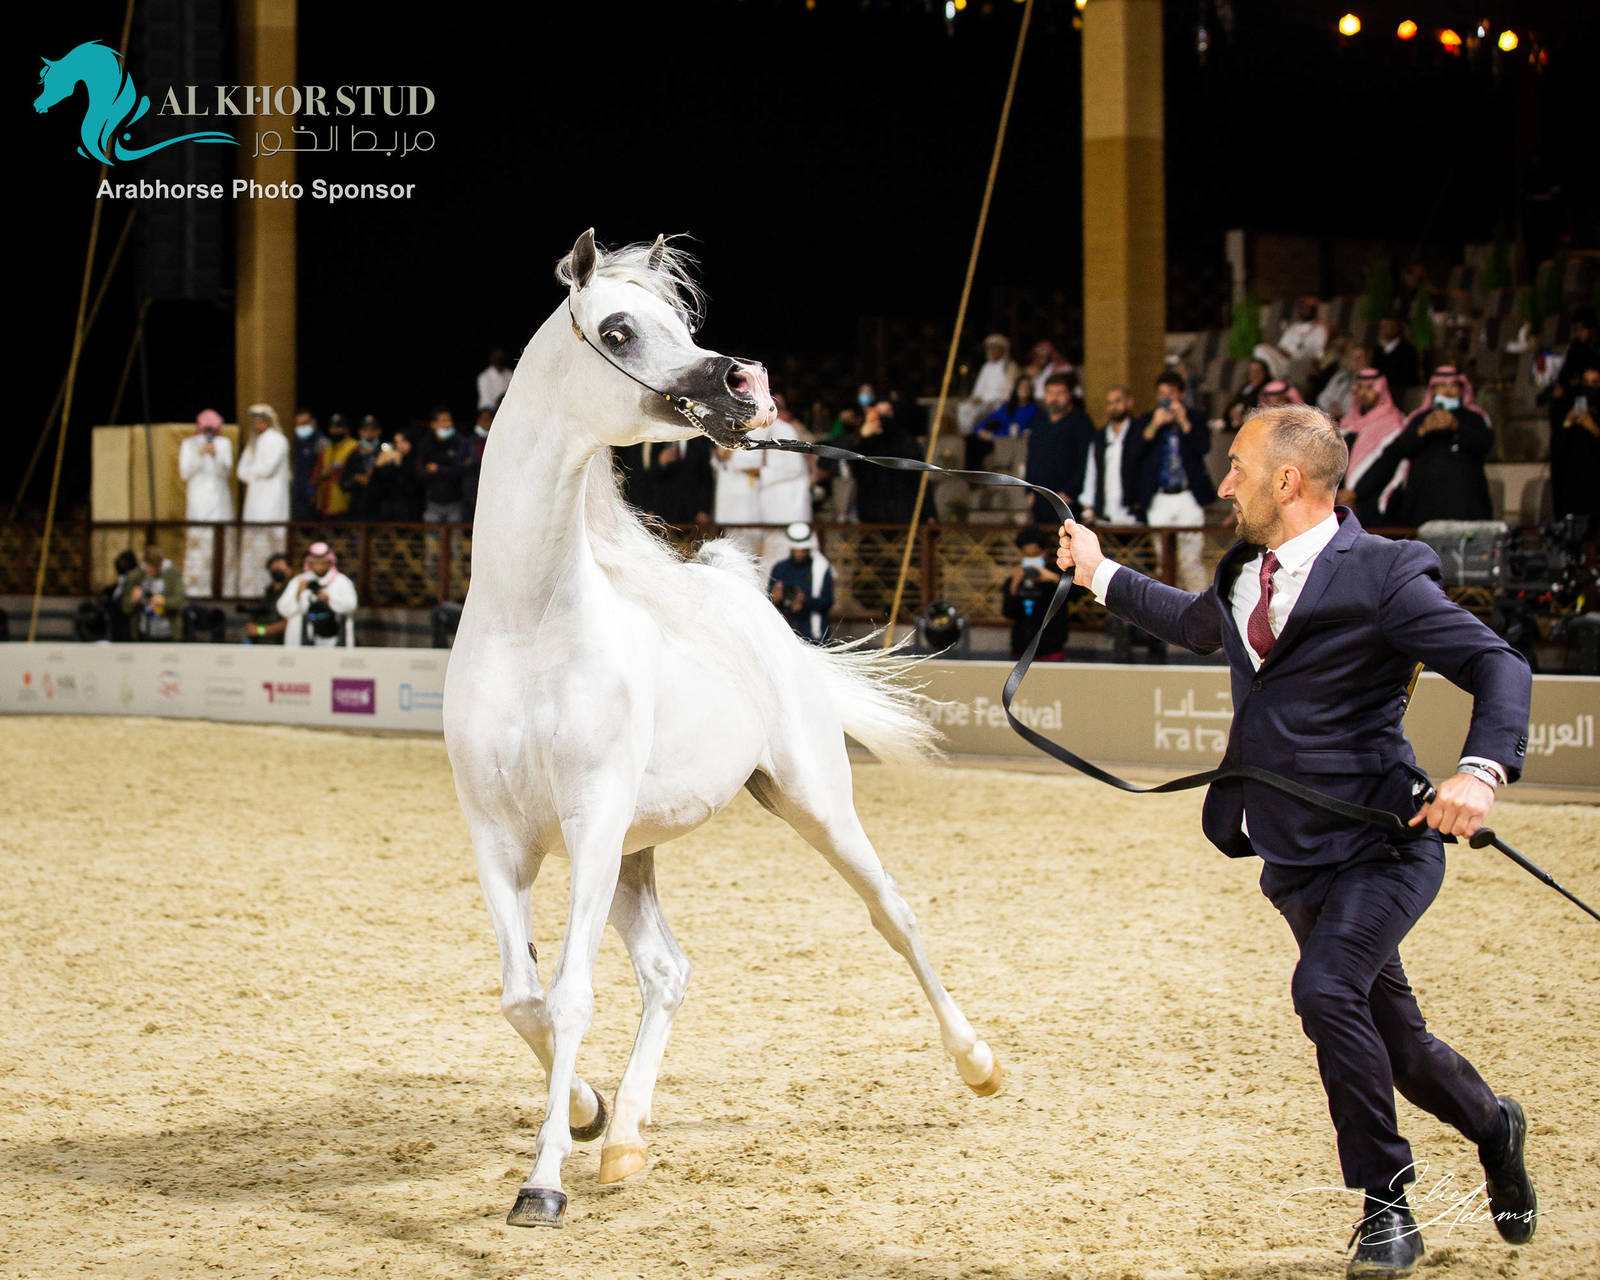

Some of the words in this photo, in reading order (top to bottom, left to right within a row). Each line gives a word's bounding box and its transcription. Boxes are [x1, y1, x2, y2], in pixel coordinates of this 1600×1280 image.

[921, 701, 970, 726] orse
[1155, 722, 1226, 753] kata
[1526, 714, 1595, 756] العربي
